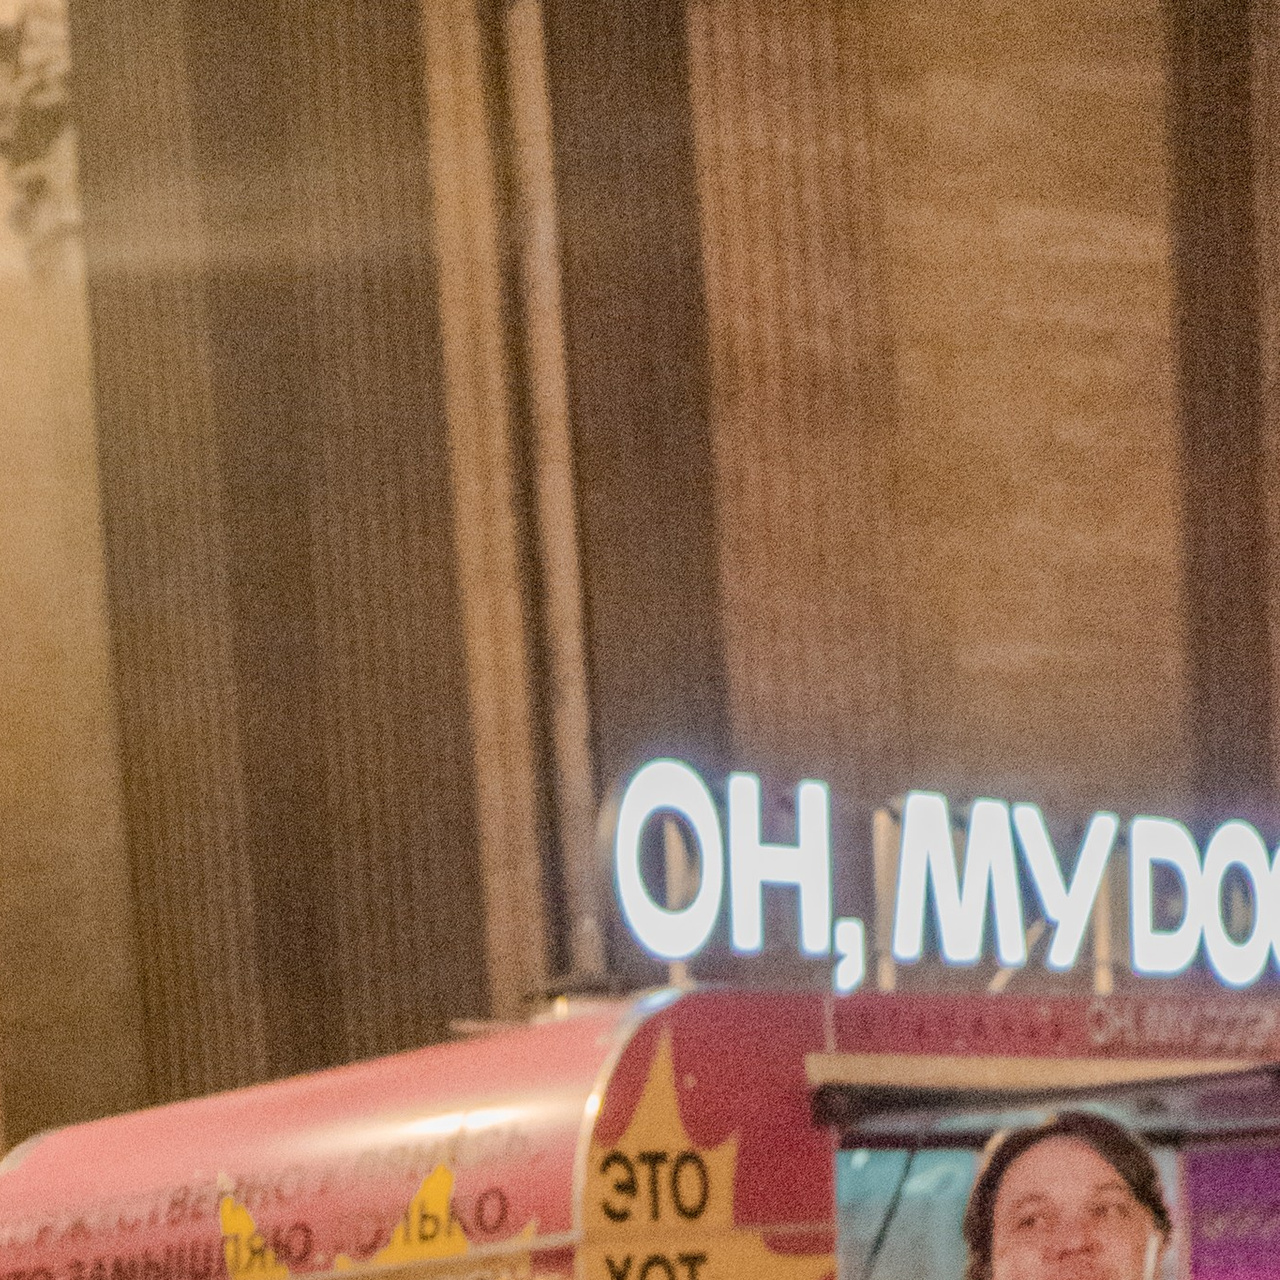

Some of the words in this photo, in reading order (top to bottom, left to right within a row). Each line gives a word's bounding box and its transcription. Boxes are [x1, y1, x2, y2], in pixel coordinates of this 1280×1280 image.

[617, 758, 865, 994] OH,
[893, 791, 1118, 971] MY
[1131, 815, 1280, 988] DO
[598, 1150, 710, 1222] ЭТО
